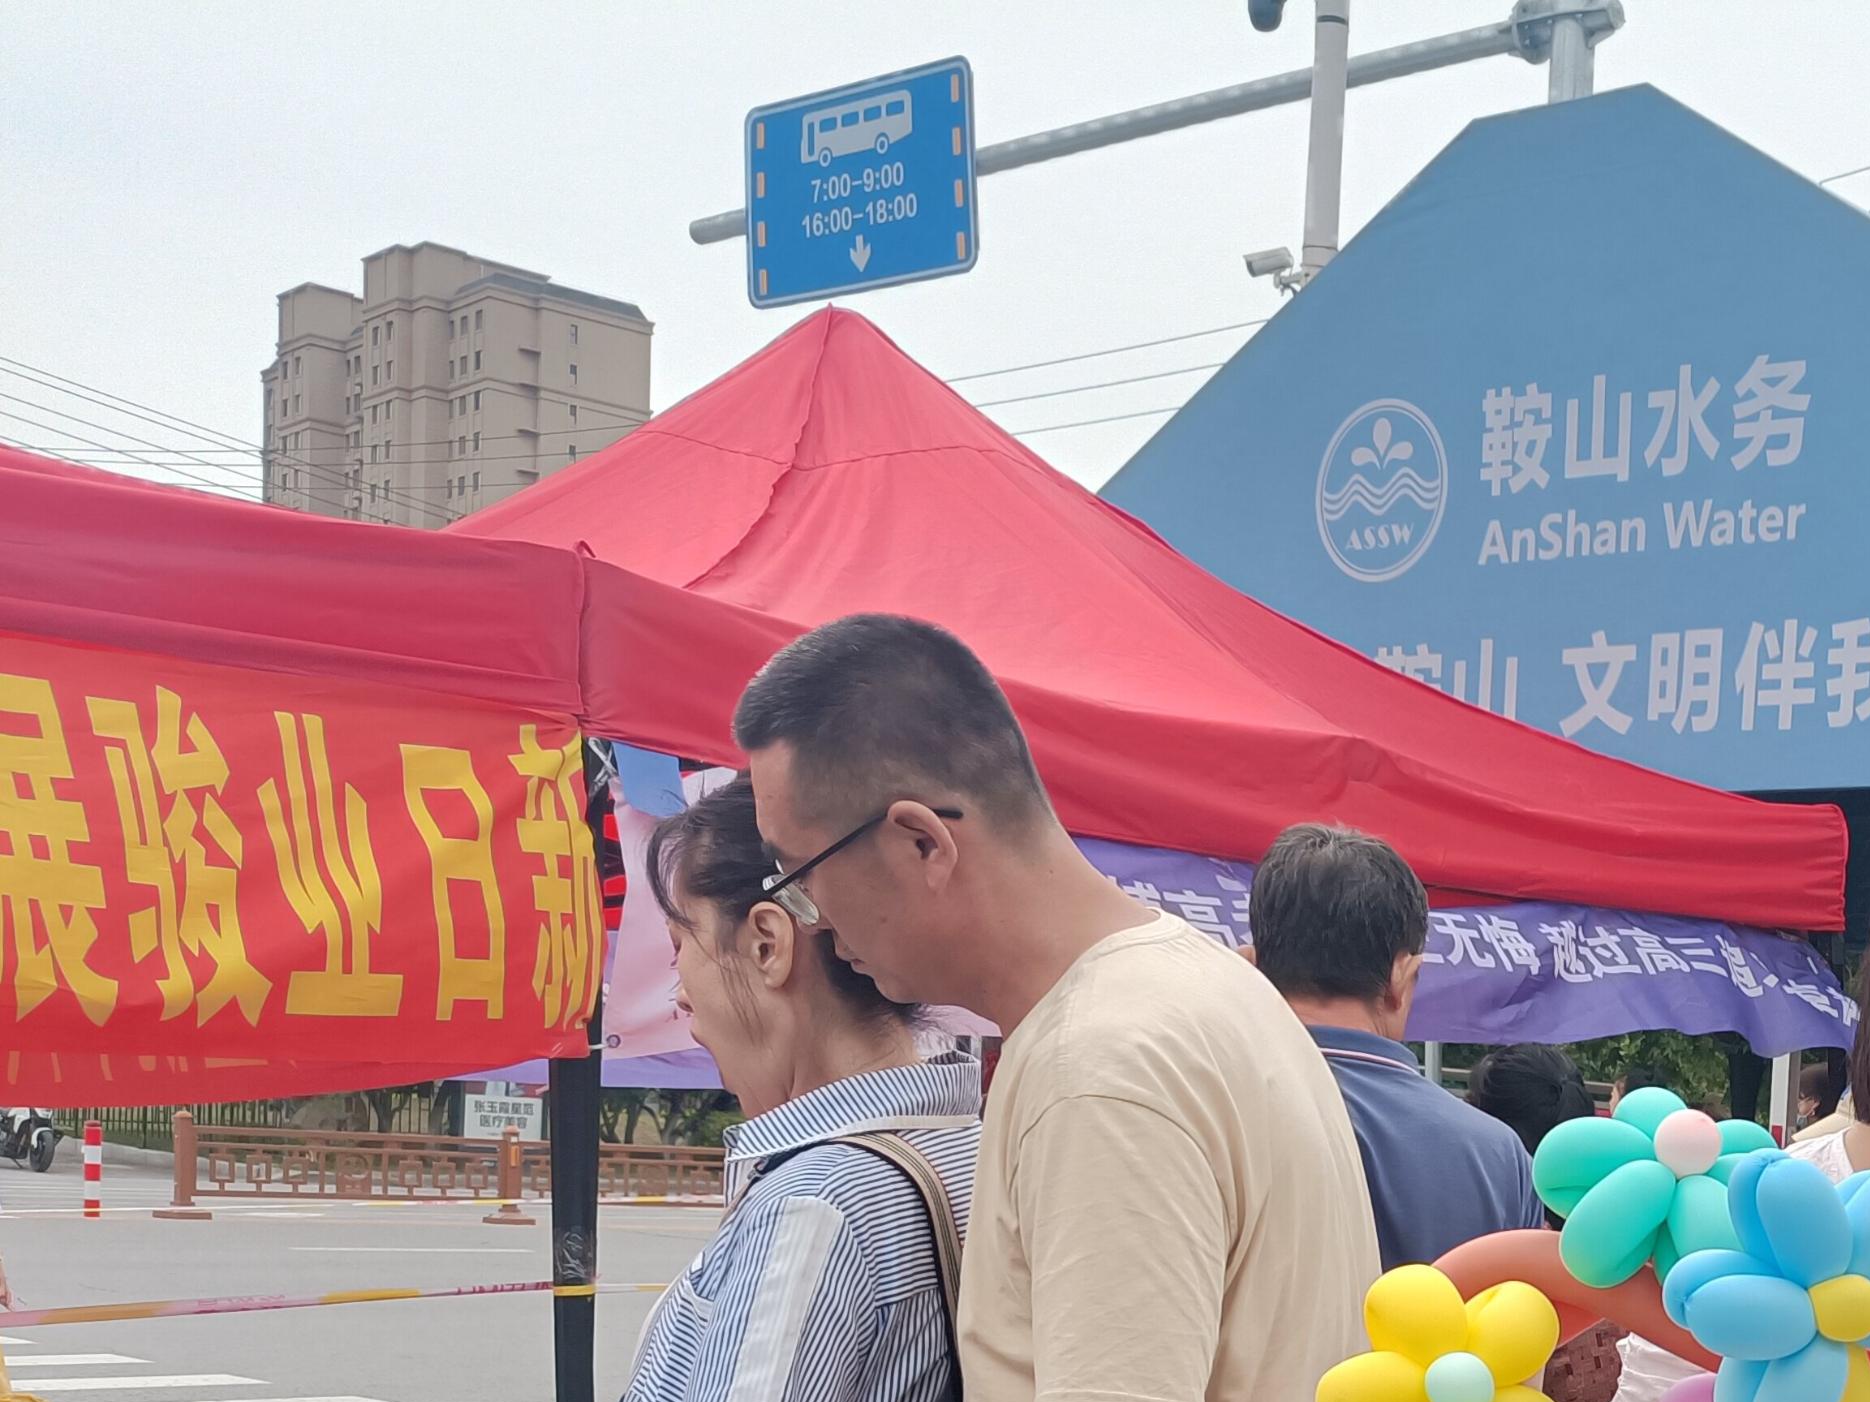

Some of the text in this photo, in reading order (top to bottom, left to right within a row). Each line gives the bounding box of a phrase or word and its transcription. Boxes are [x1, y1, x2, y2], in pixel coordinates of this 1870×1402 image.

[1480, 354, 1811, 497] 鞍山水务
[1345, 523, 1415, 551] ASSW
[1478, 498, 1807, 566] AnShan Water
